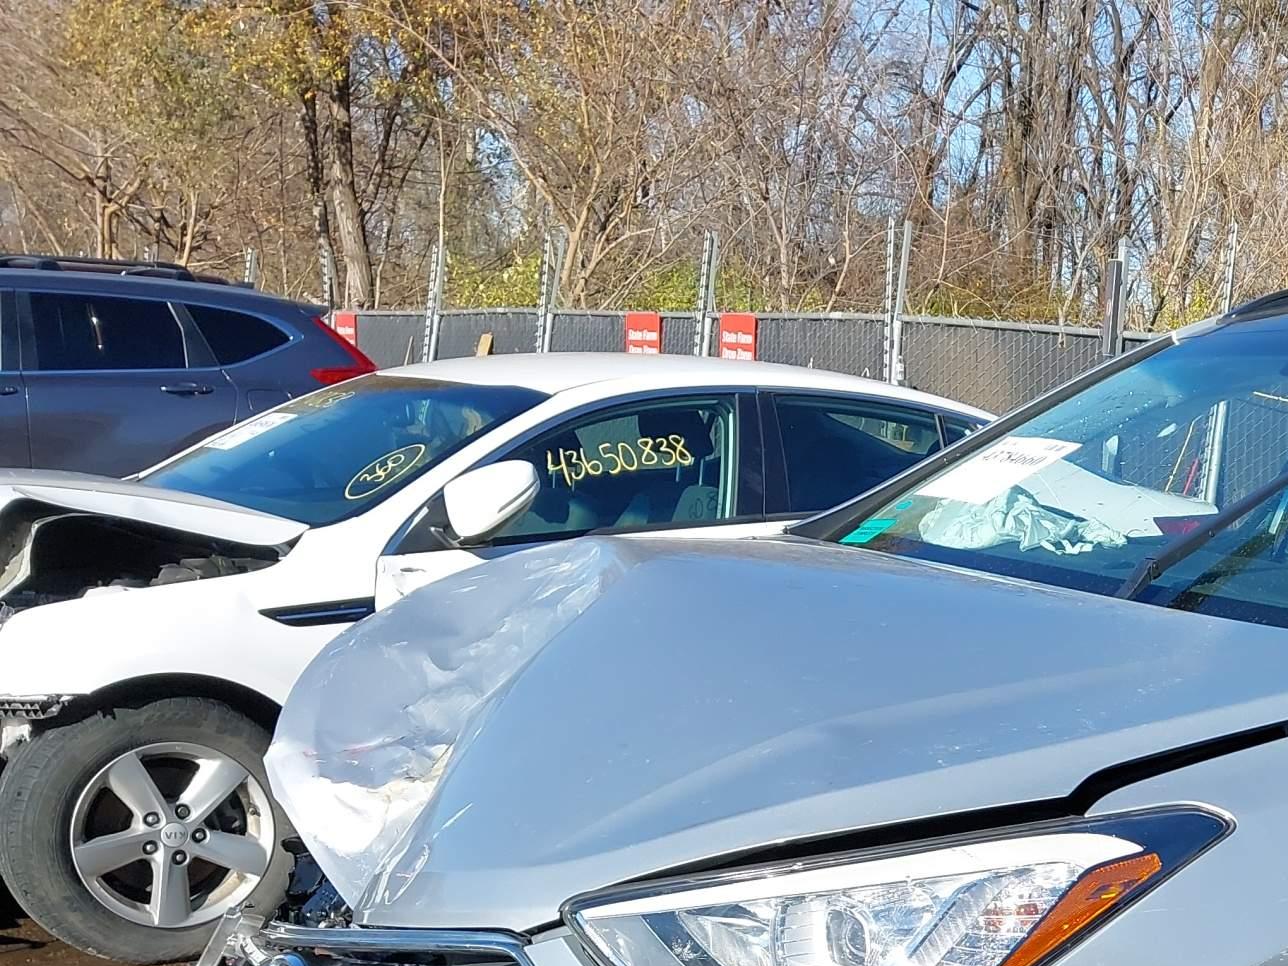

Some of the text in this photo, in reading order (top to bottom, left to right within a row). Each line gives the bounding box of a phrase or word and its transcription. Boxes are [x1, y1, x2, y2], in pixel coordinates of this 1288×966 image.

[722, 331, 753, 344] State Farm
[359, 454, 405, 482] 360
[547, 434, 695, 486] 43650838
[165, 831, 186, 840] KIA
